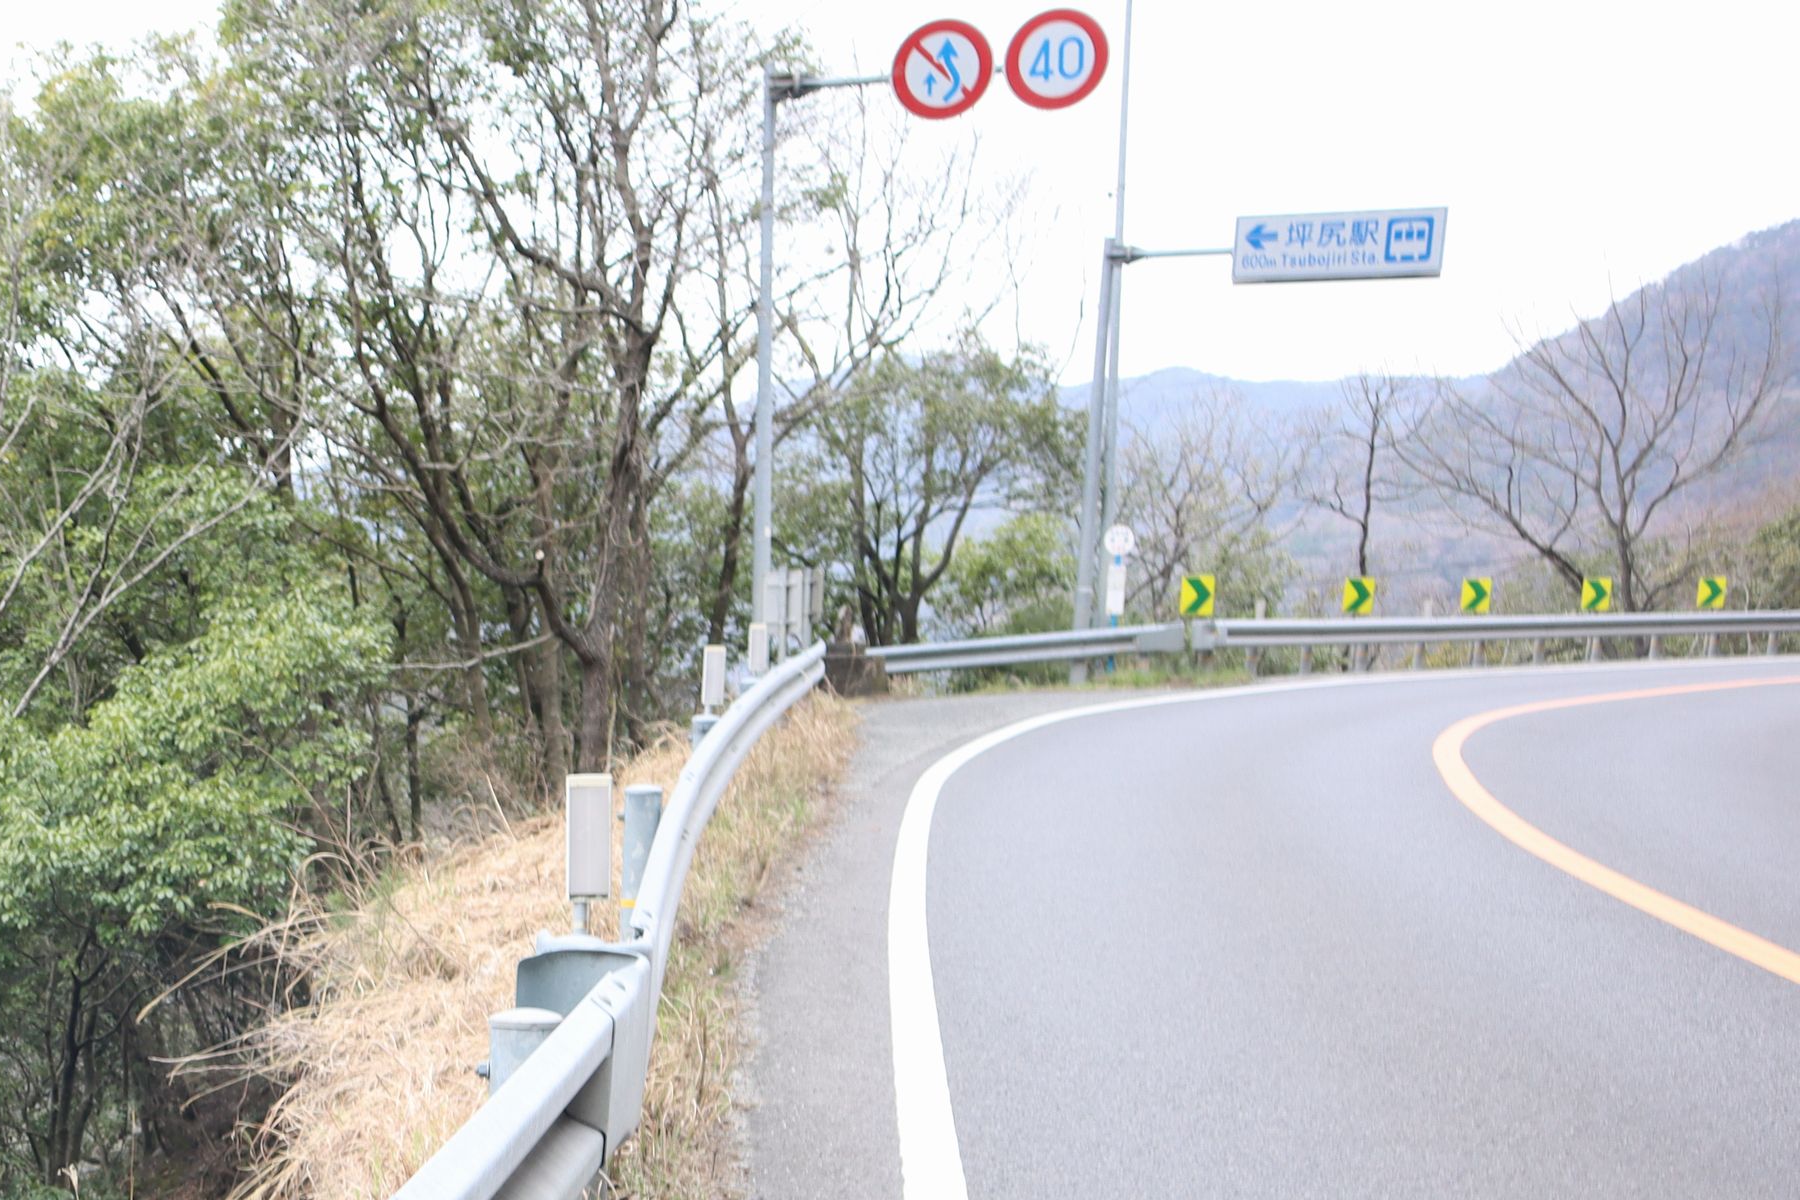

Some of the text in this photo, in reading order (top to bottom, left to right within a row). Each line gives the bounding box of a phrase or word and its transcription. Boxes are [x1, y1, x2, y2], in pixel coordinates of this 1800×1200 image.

[1029, 36, 1085, 81] 40
[1285, 219, 1379, 248] 坪尻駅
[1282, 250, 1347, 270] Tsubojiri
